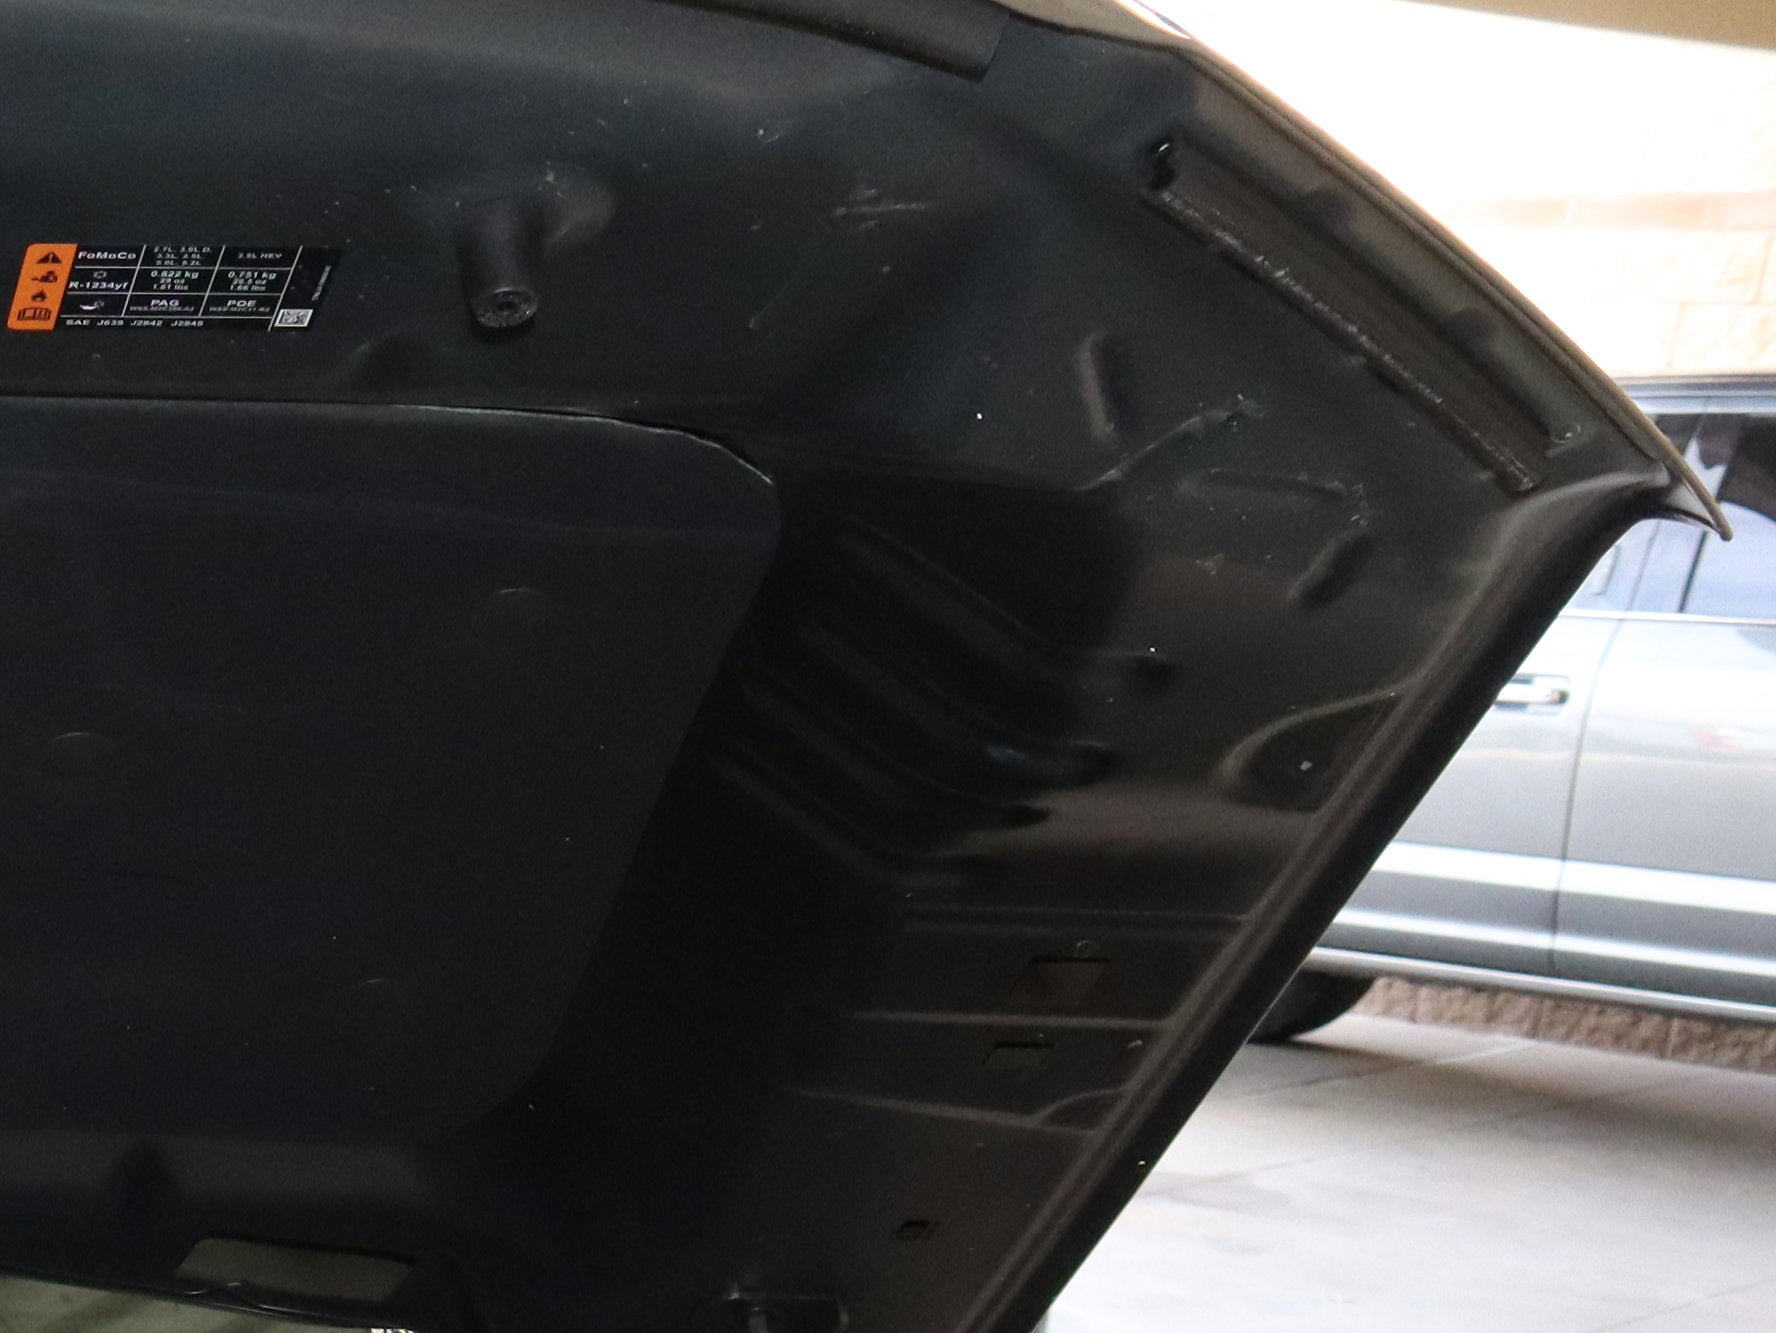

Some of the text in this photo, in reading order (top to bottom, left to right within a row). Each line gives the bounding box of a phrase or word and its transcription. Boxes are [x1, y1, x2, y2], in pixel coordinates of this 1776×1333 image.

[77, 251, 137, 260] FoMoCo
[184, 270, 200, 280] kg
[261, 271, 277, 280] kg
[68, 281, 128, 291] R-1234yf
[150, 299, 180, 307] PAG
